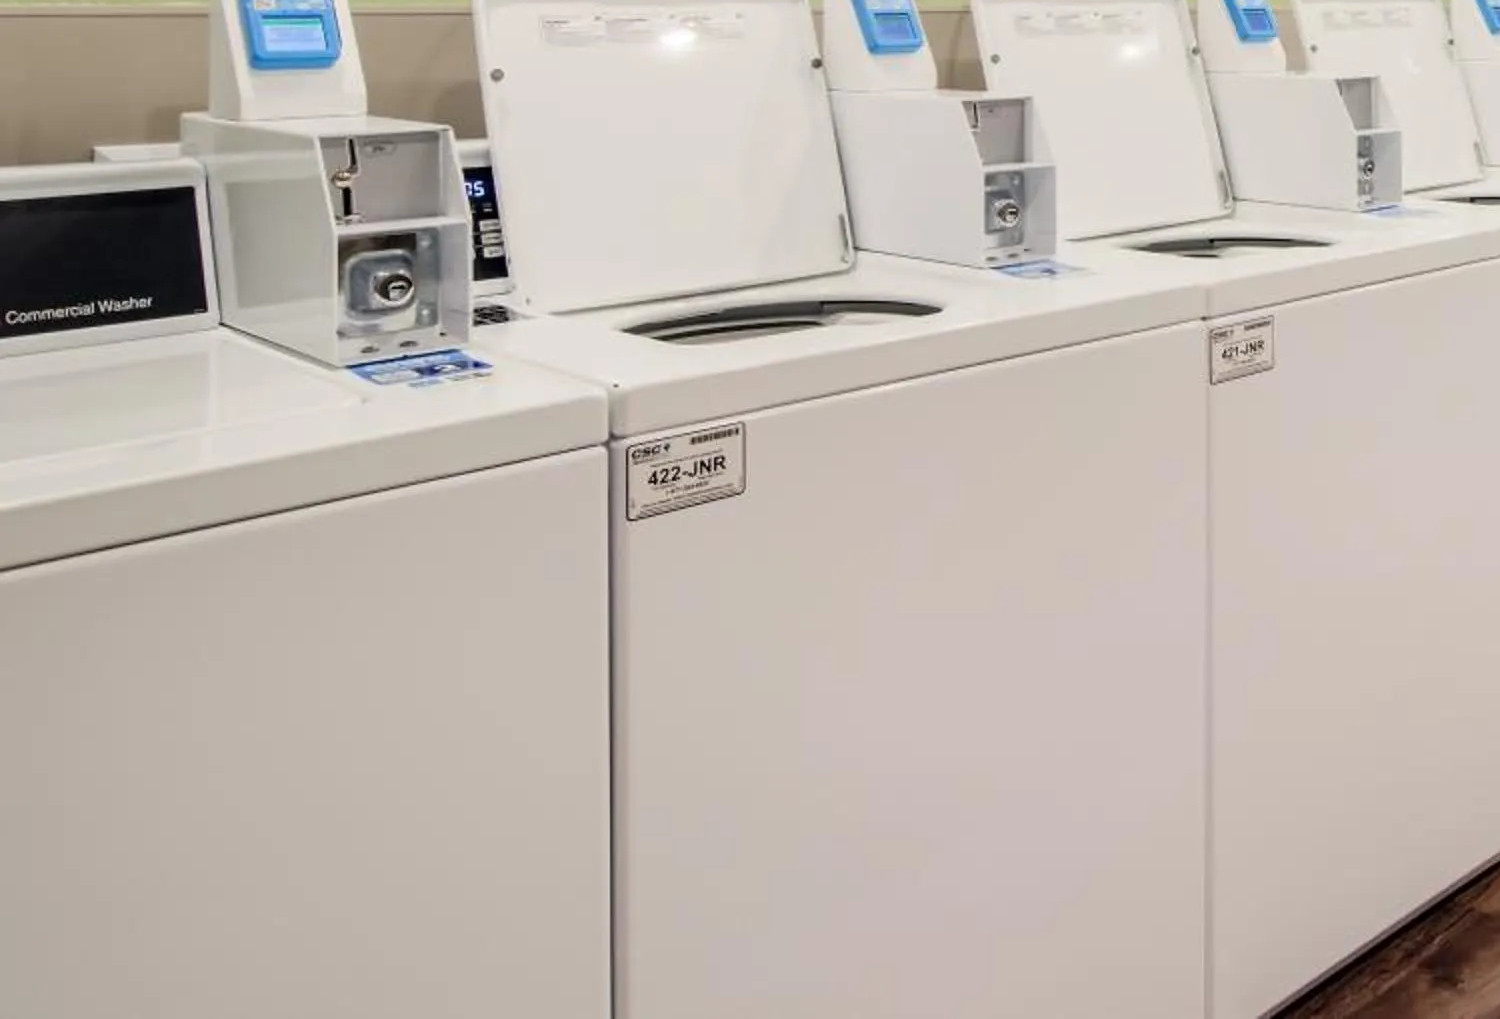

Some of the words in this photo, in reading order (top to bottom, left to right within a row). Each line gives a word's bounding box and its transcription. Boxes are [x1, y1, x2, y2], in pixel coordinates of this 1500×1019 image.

[5, 301, 95, 325] Commercial
[97, 295, 153, 314] Washer
[631, 444, 661, 460] CSC
[647, 455, 727, 486] 422-JNR
